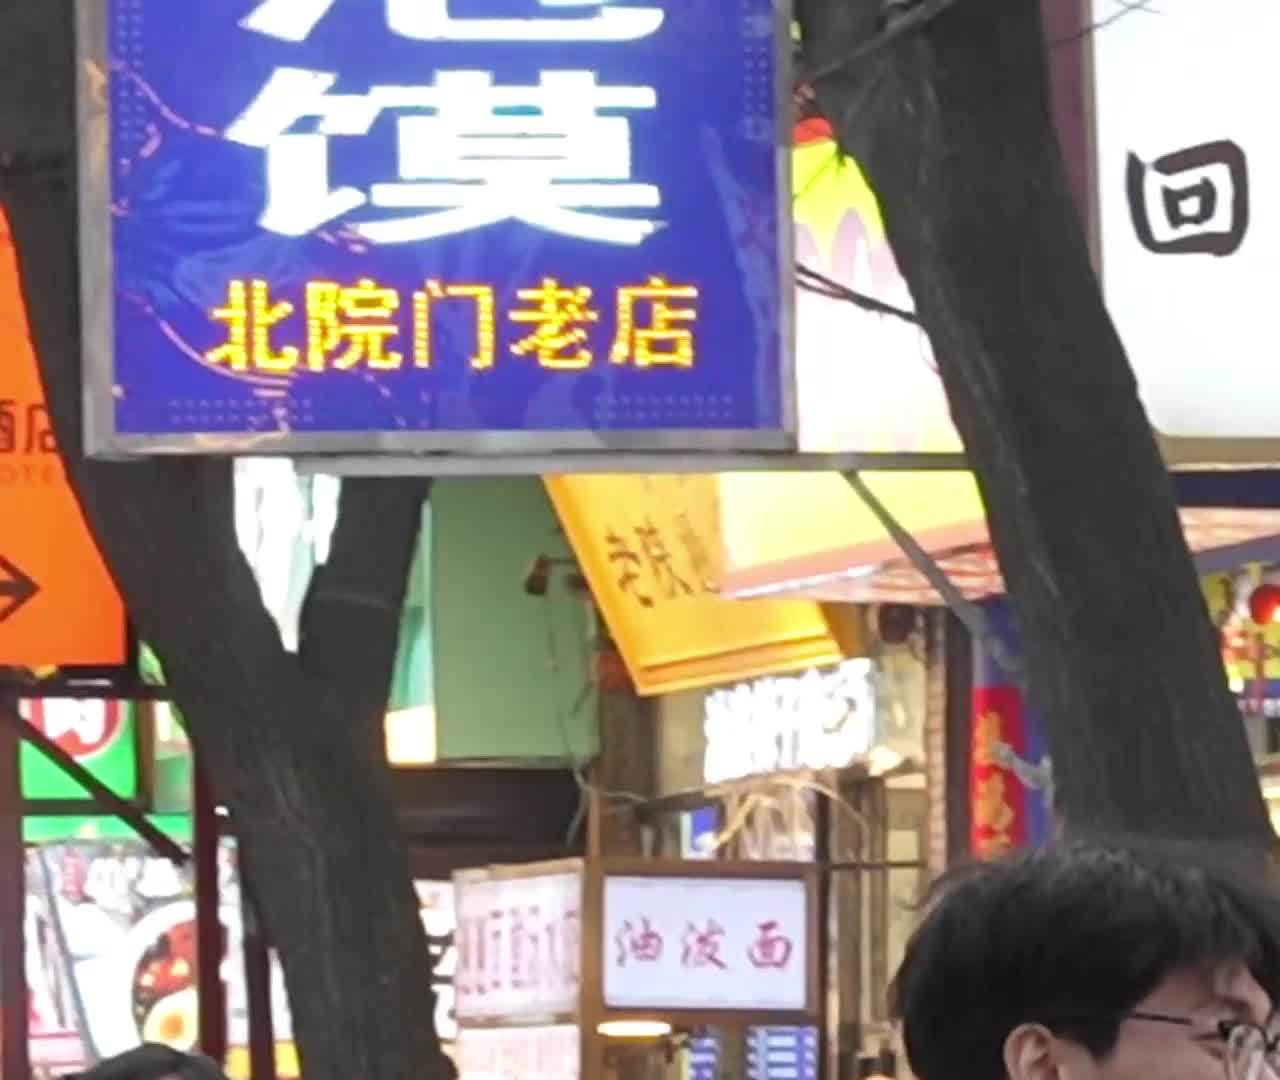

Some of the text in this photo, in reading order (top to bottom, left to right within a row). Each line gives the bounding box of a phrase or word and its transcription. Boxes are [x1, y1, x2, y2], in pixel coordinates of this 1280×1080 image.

[205, 278, 700, 372] 北院门老店
